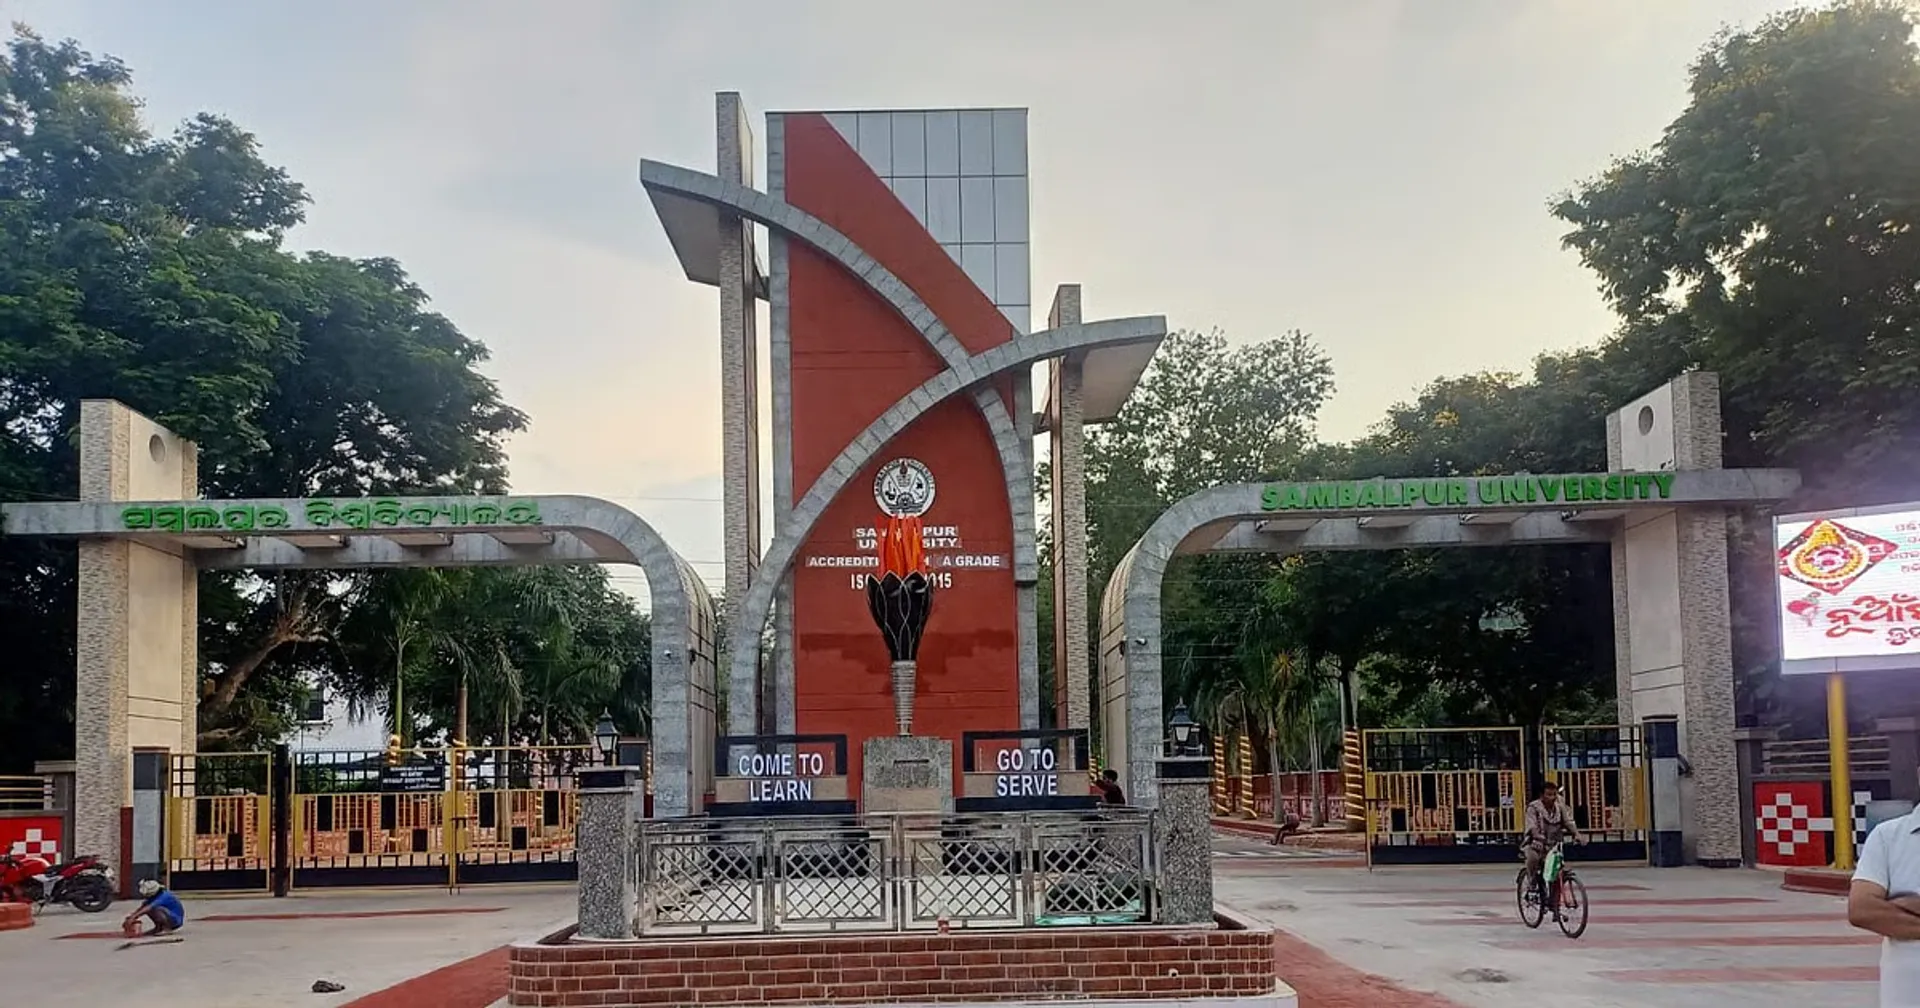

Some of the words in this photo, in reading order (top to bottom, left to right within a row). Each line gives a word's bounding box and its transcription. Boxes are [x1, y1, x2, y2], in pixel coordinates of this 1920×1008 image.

[1261, 478, 1467, 510] SAMBALPUR
[1478, 474, 1676, 506] UNIVERSITY
[943, 555, 952, 566] A
[955, 555, 1000, 567] GRADE
[738, 753, 792, 777] COME
[798, 752, 823, 775] TO
[997, 748, 1024, 771] GO
[1030, 747, 1055, 770] TO
[749, 778, 812, 802] LEARN
[997, 773, 1058, 797] SERVE
